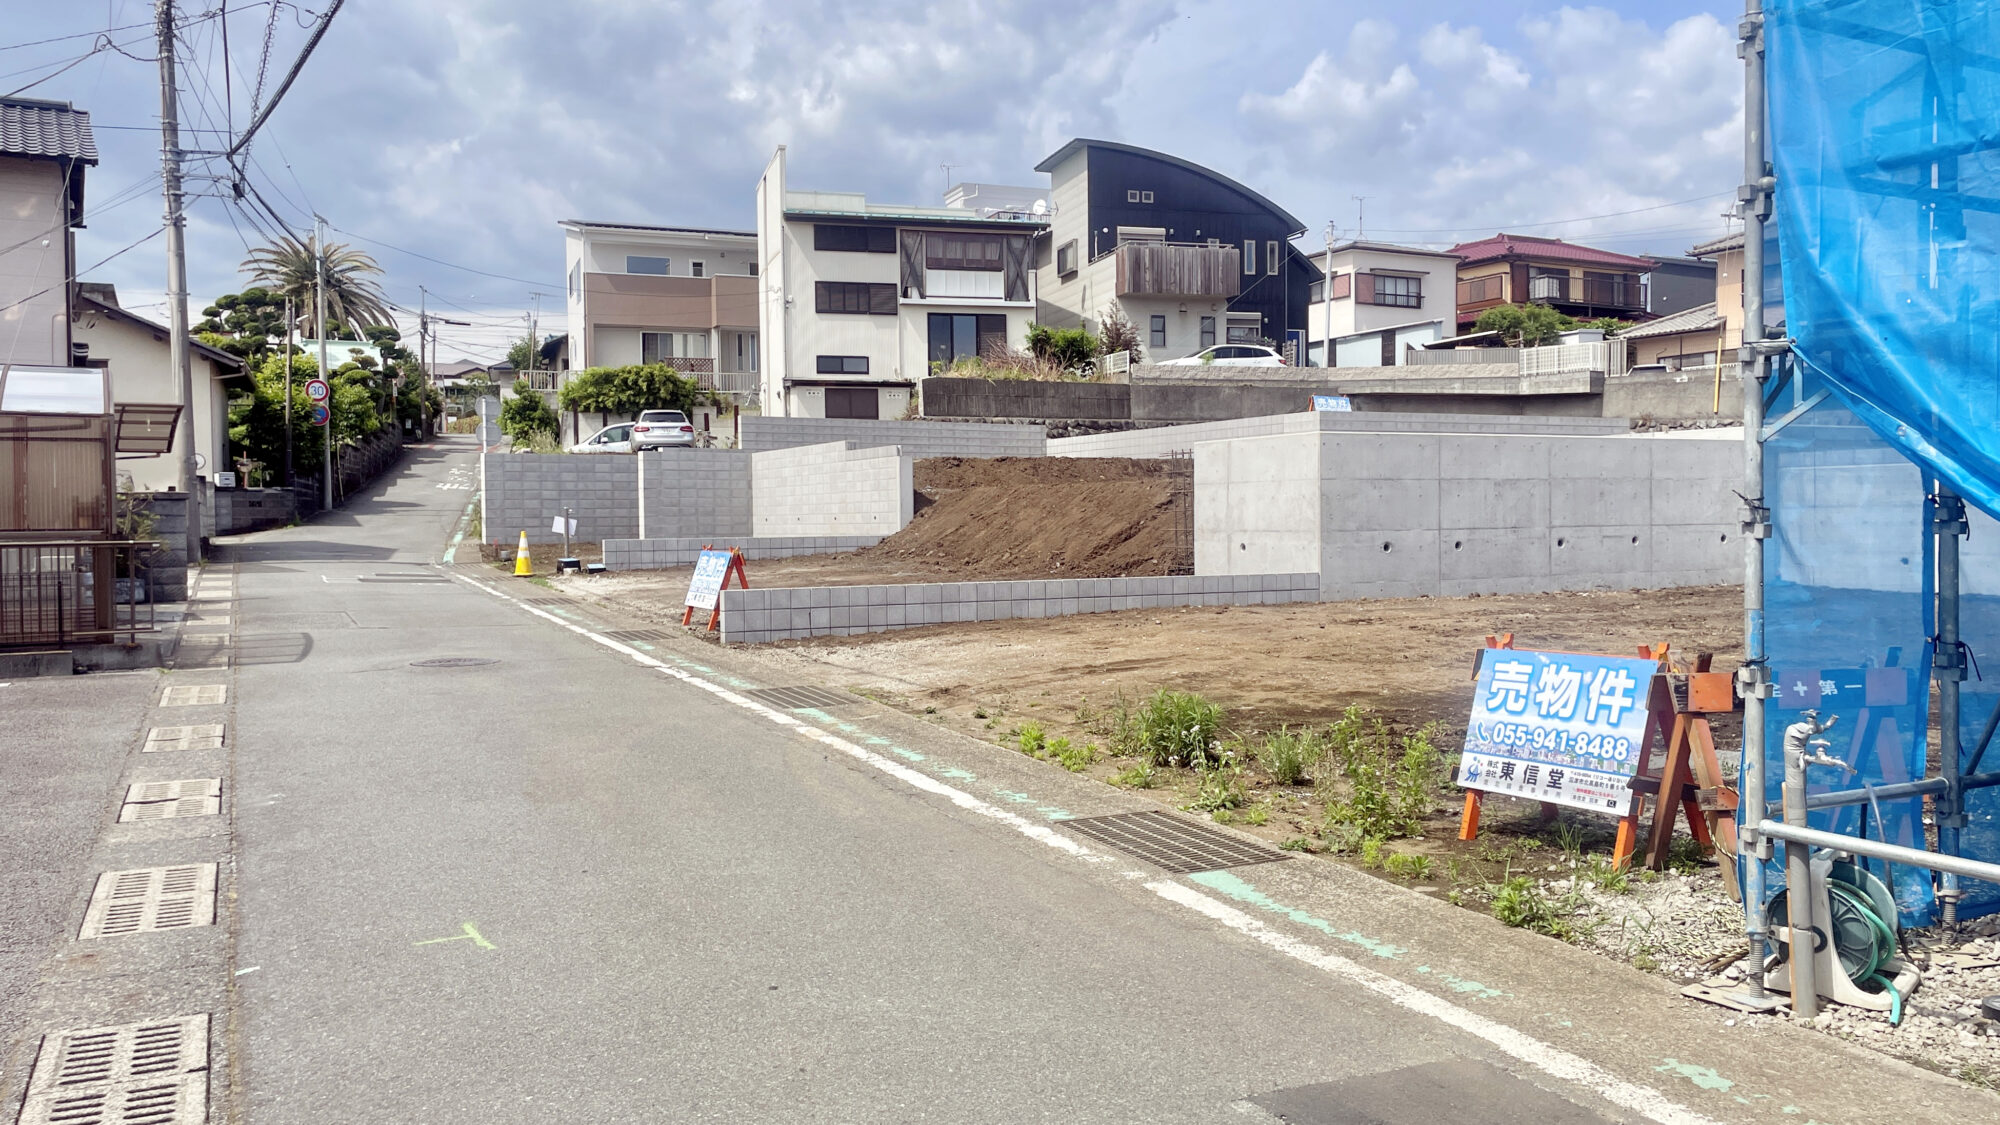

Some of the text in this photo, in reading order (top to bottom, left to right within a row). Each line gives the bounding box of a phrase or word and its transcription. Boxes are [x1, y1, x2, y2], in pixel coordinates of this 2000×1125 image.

[310, 385, 325, 396] 30
[1487, 661, 1636, 724] 売物件
[1819, 680, 1863, 696] 第一
[1492, 722, 1630, 762] 055-941-8488
[1499, 761, 1565, 790] 東信堂
